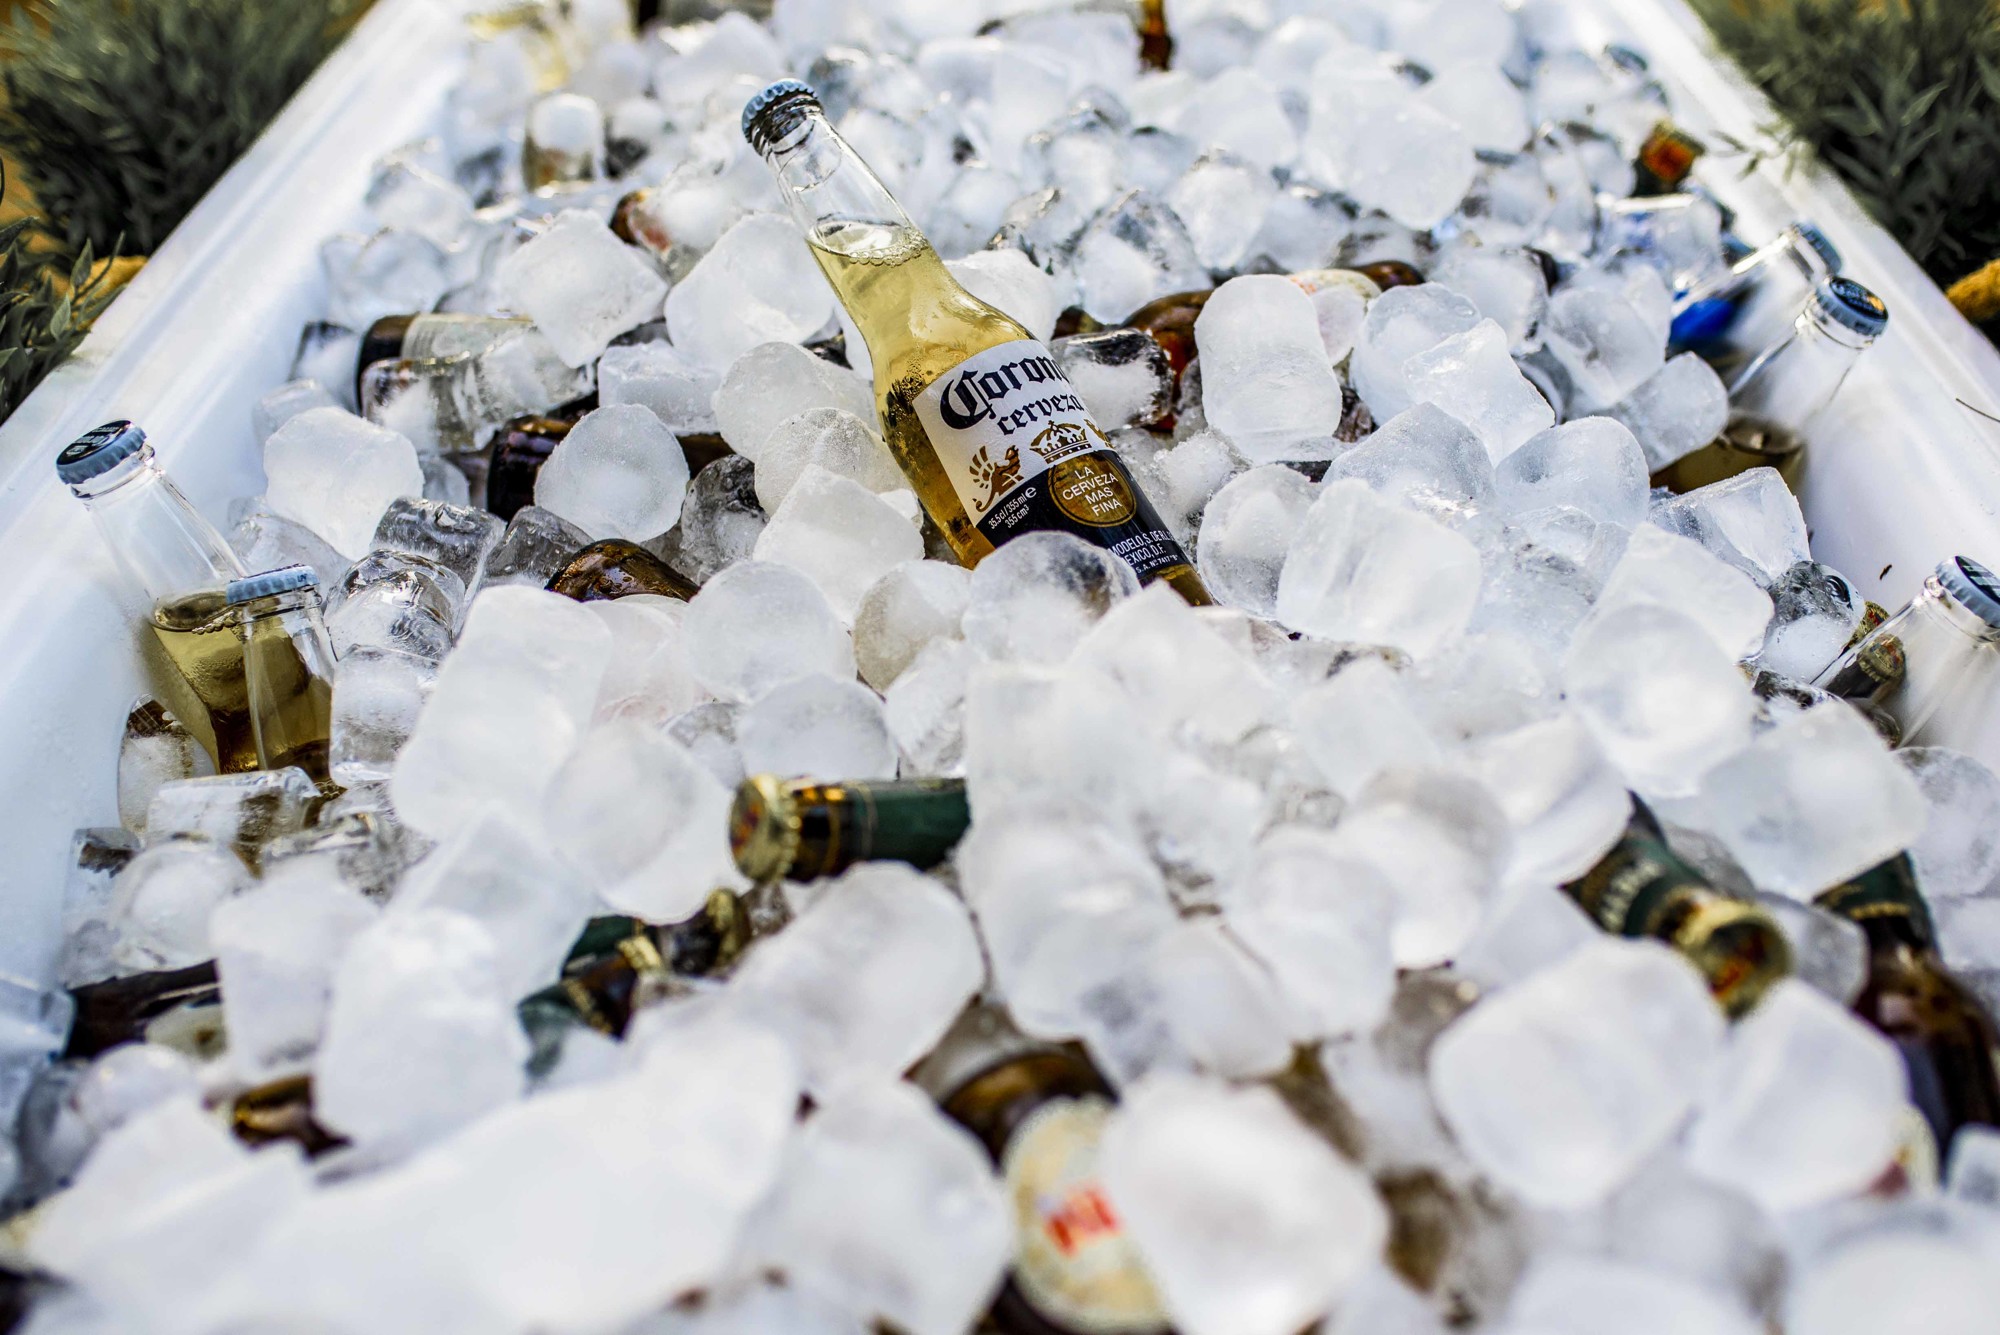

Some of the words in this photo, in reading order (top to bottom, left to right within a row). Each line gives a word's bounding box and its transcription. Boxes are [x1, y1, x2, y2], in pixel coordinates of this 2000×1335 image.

[996, 393, 1085, 436] cerveza
[1074, 466, 1095, 480] LA
[1062, 472, 1119, 500] CERVEZA
[1085, 486, 1114, 505] MAS
[1091, 498, 1123, 517] FINA
[1124, 547, 1154, 566] EXICO,
